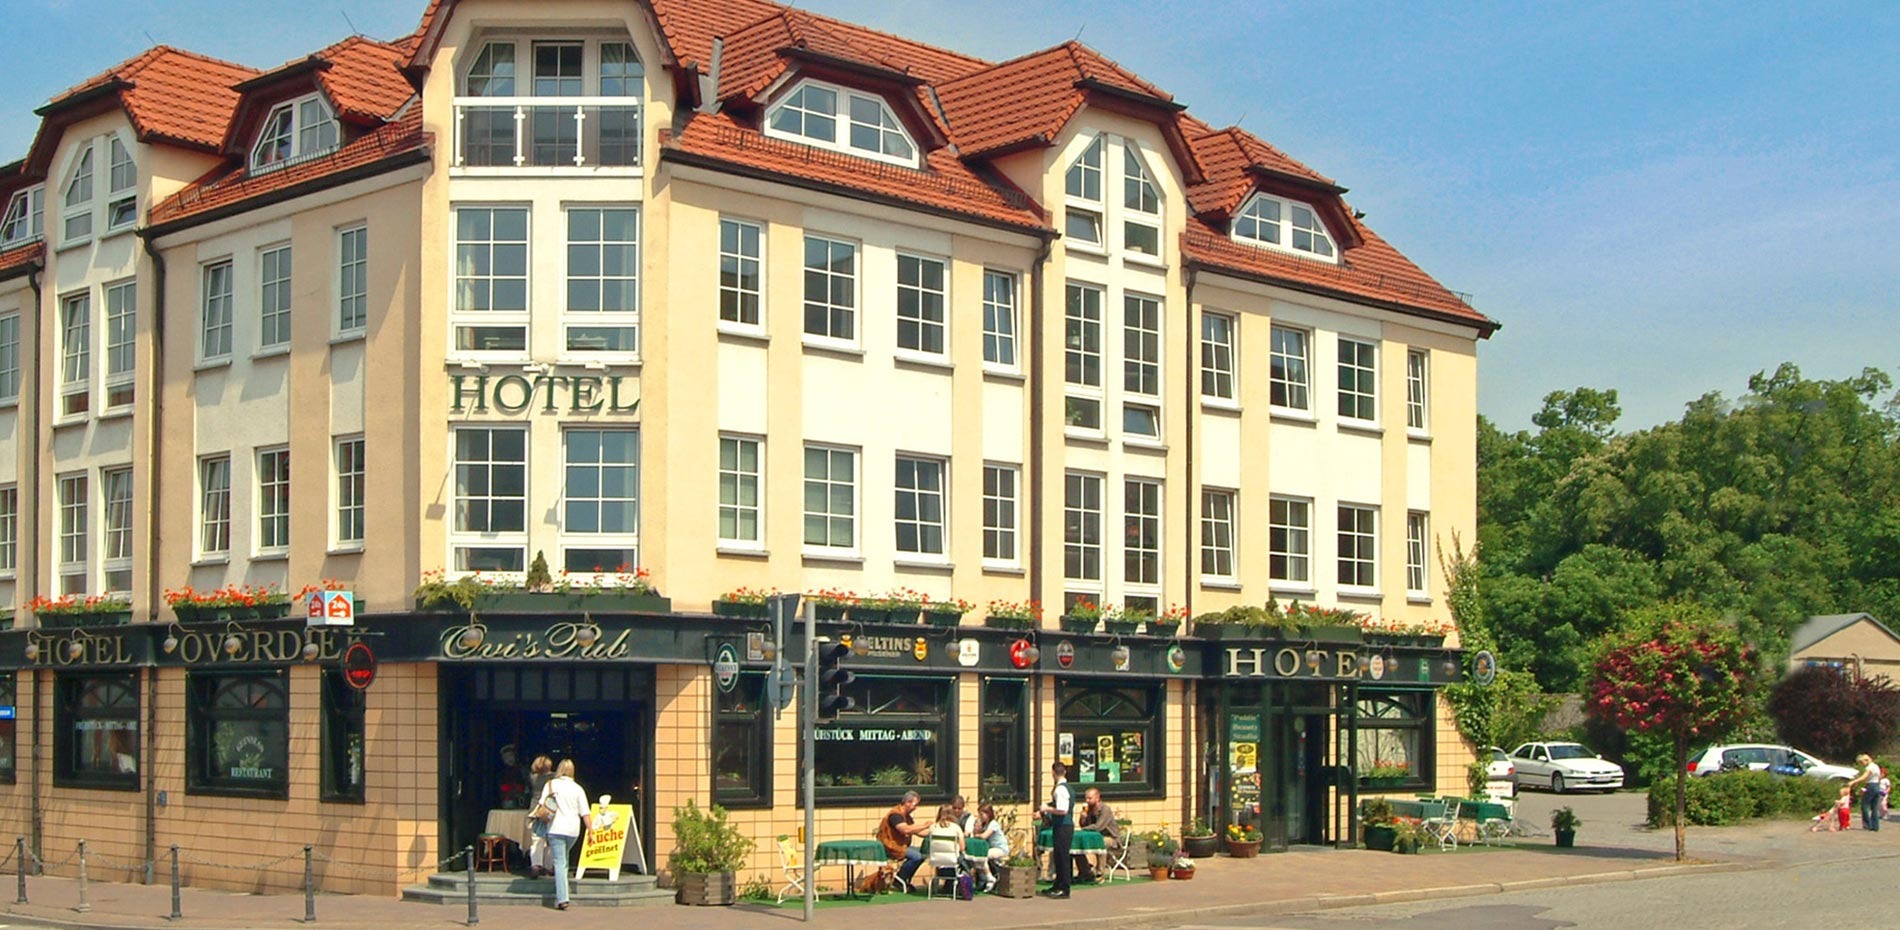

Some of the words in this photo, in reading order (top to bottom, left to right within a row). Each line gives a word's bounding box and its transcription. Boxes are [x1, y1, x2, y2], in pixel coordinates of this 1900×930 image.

[450, 375, 640, 410] HOTEL
[34, 636, 132, 665] HOTEL
[440, 624, 541, 659] Ovi's
[545, 622, 631, 659] Pub
[857, 636, 911, 652] ELTINS
[1226, 648, 1363, 678] HOTE
[859, 729, 895, 740] MITTAG
[901, 729, 931, 740] ABEND
